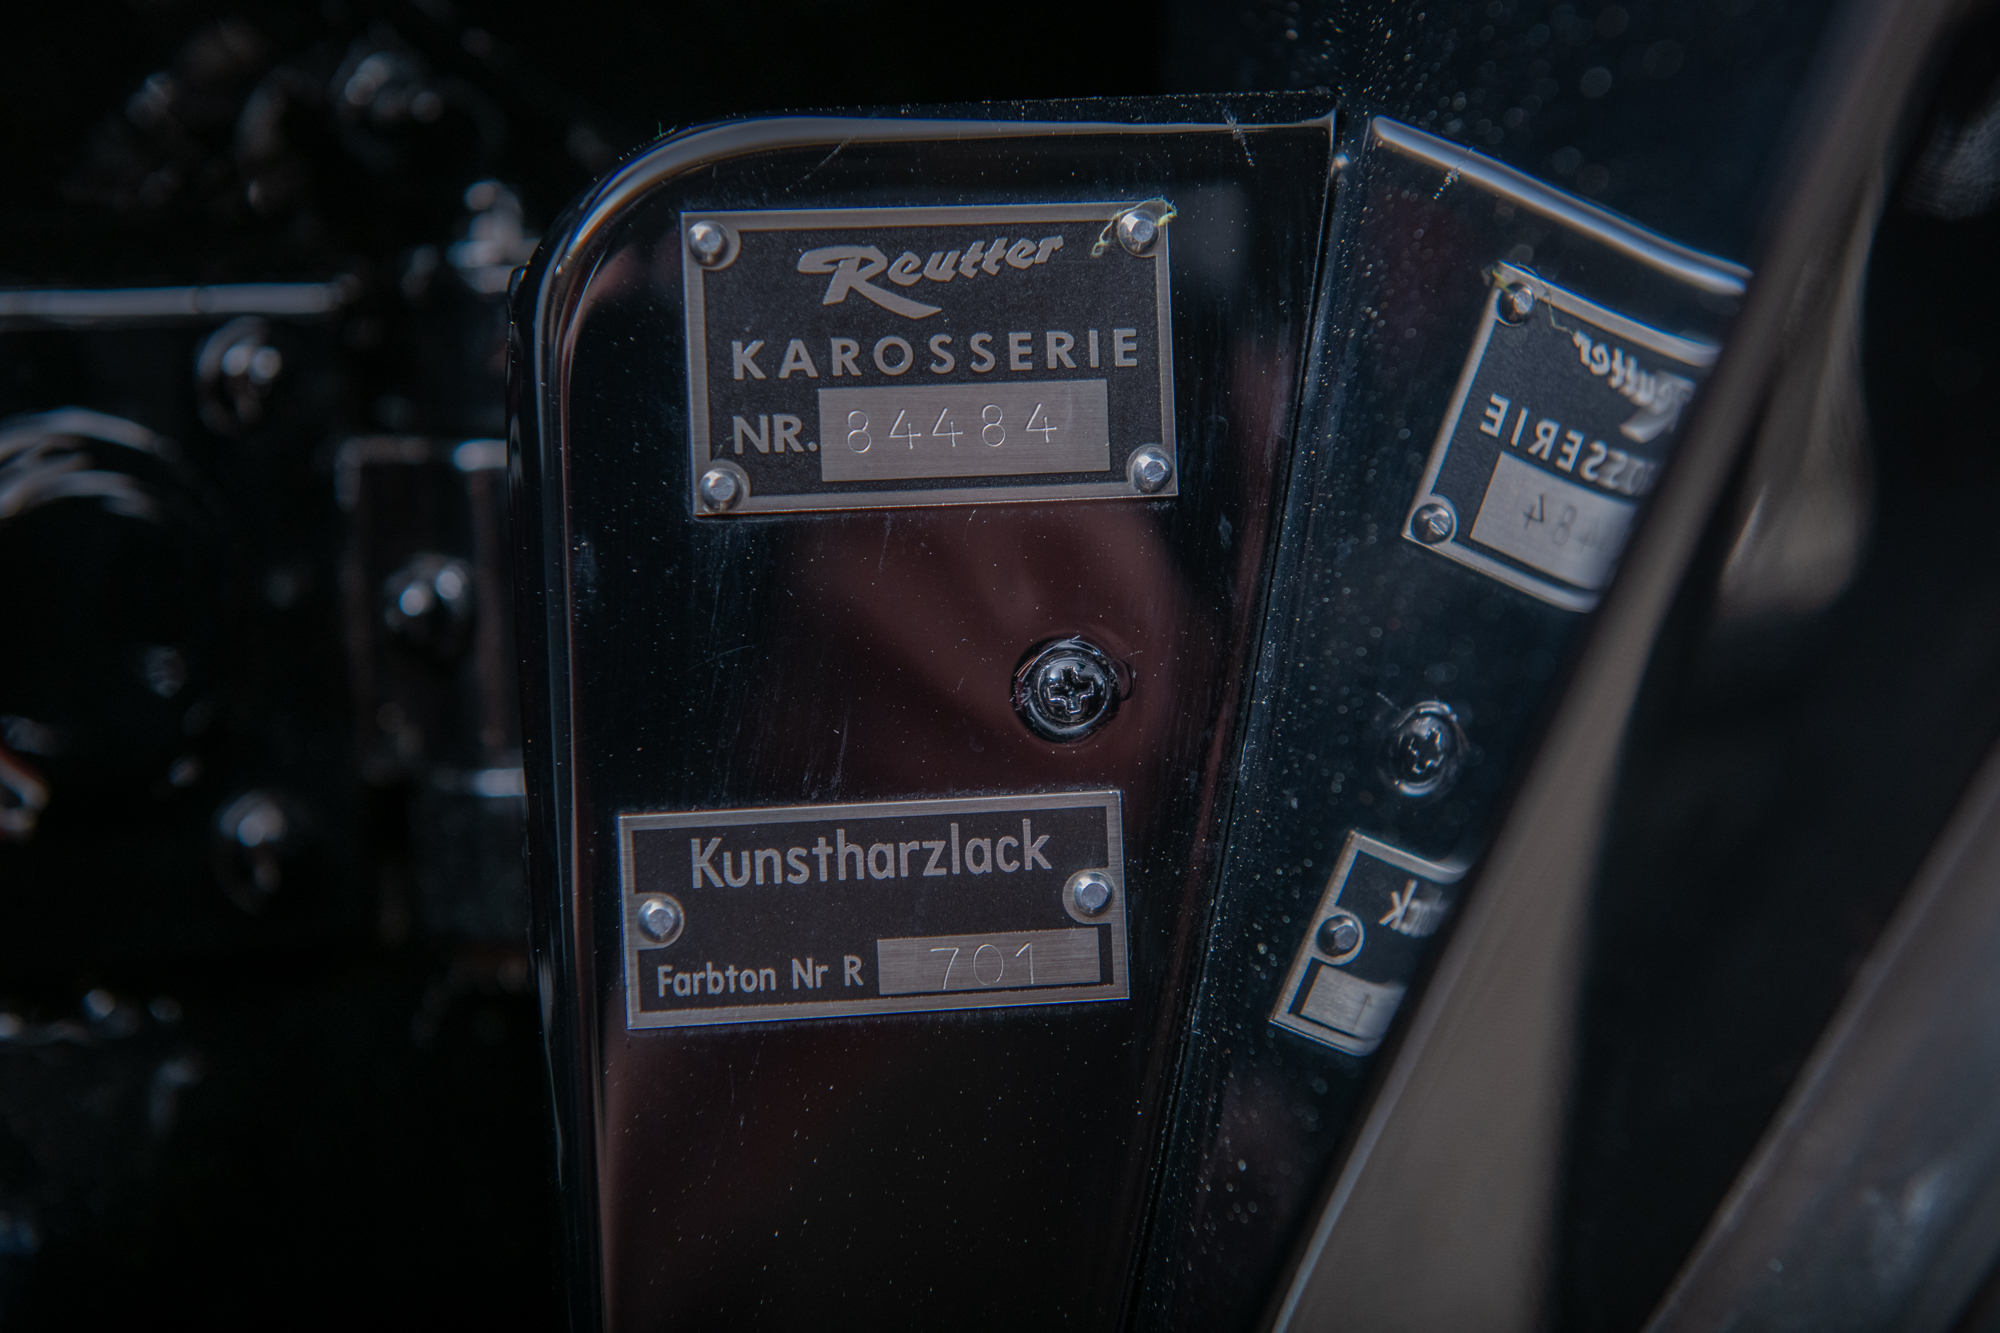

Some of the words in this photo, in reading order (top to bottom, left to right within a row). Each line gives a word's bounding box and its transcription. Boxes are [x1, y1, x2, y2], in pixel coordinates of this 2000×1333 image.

[798, 235, 1063, 319] Reutter
[731, 328, 1138, 381] KAROSSERIE
[732, 412, 819, 455] NR.
[846, 403, 1058, 454] 84484
[690, 818, 1053, 889] Kunstharzlack
[657, 962, 777, 998] Farbton
[792, 957, 828, 990] Nr
[844, 954, 864, 987] R
[930, 942, 1036, 990] 701
